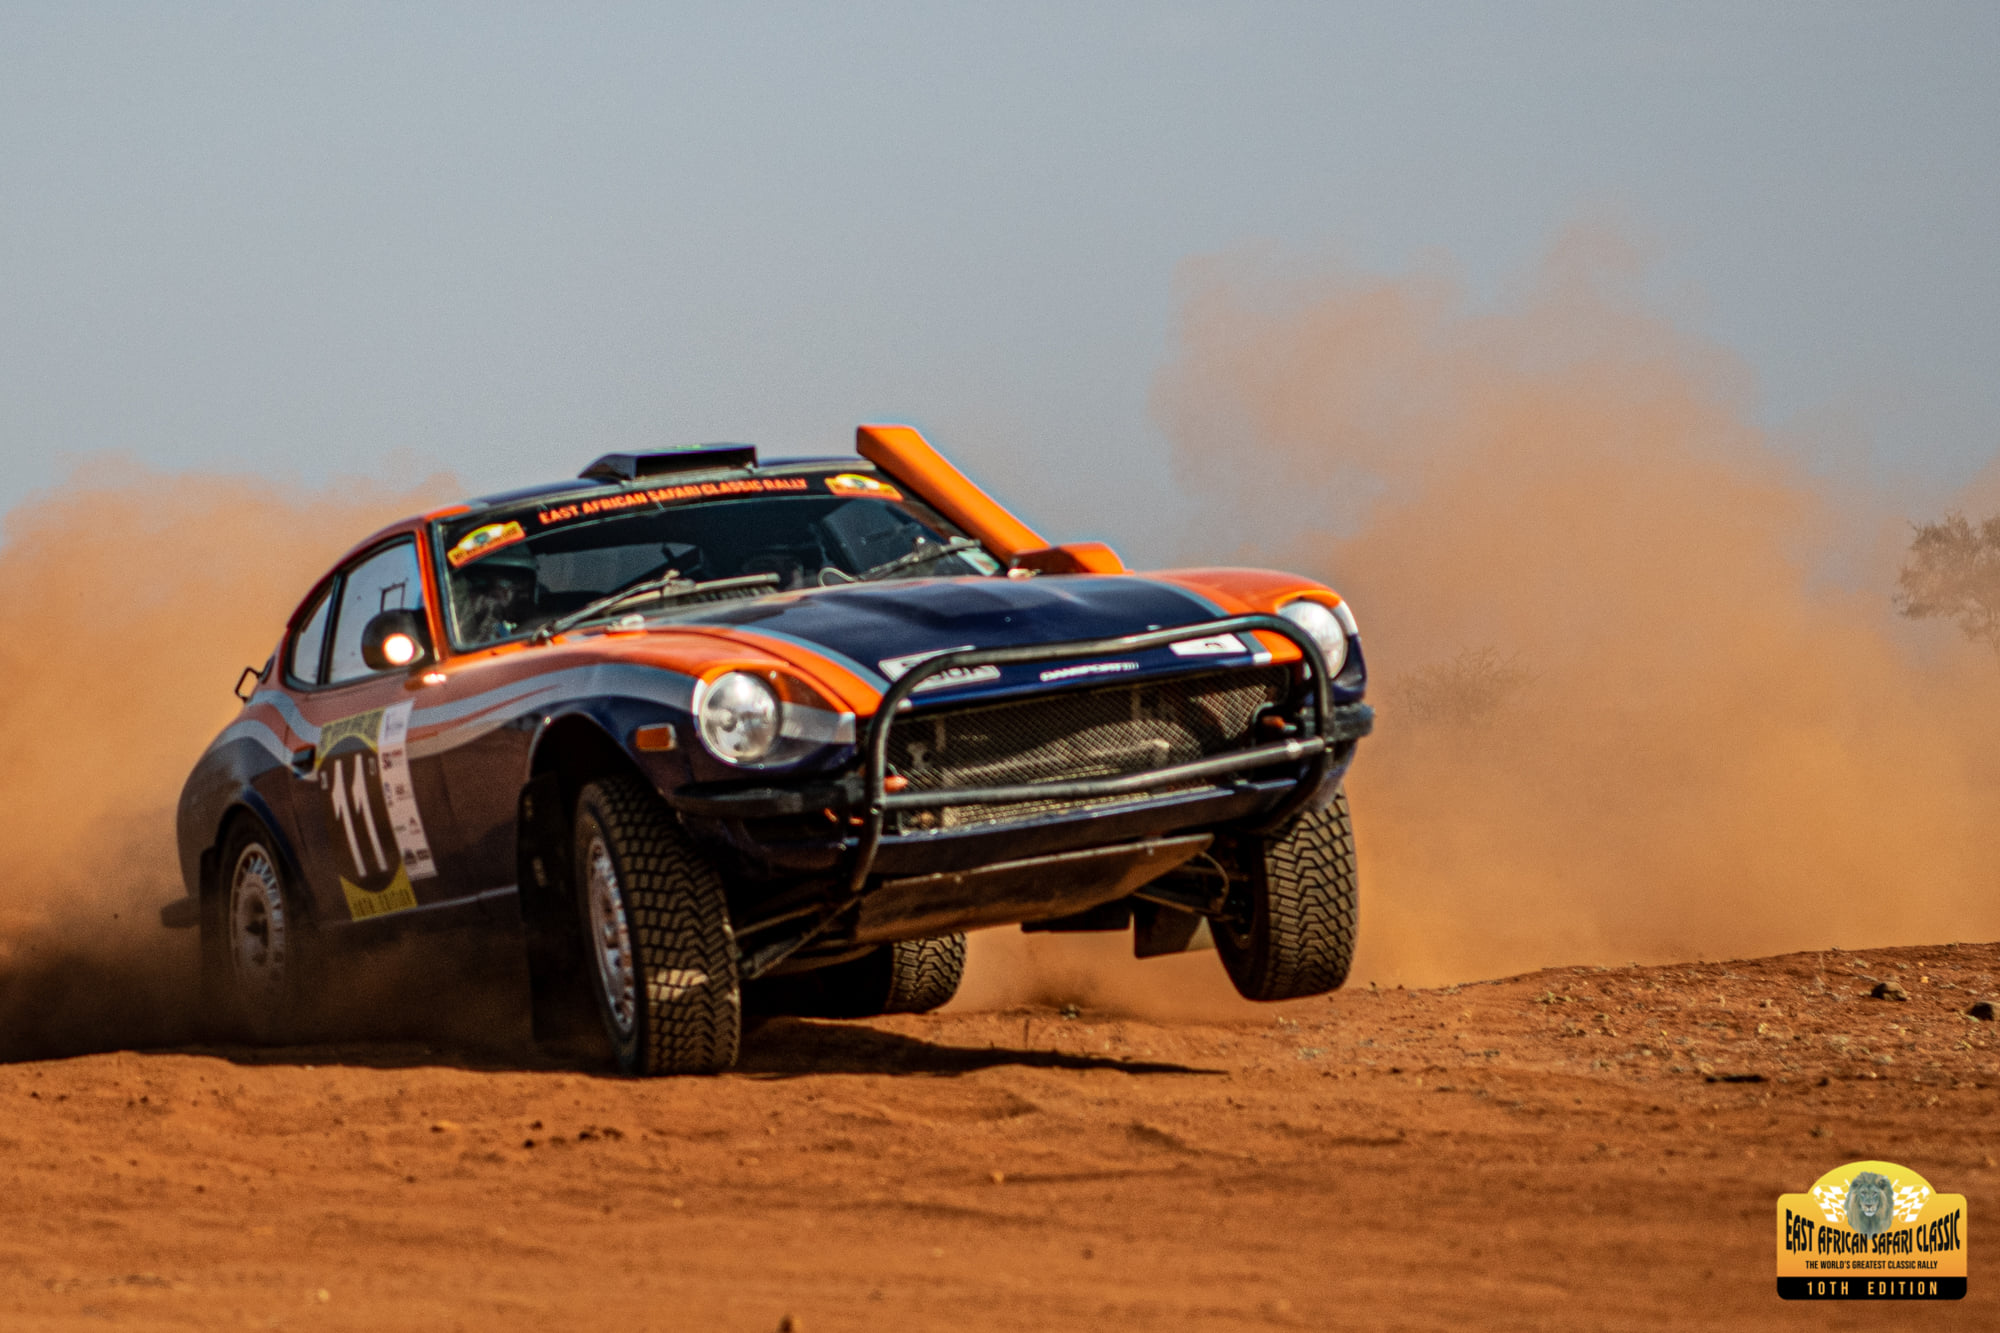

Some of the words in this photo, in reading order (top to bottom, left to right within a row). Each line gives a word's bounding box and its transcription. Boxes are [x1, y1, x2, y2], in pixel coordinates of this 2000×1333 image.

[538, 504, 579, 525] EAST
[581, 492, 648, 515] AFRICAN
[647, 485, 701, 503] SAFARI
[700, 480, 763, 497] CLASSIC
[762, 477, 808, 492] RALLY
[331, 752, 388, 878] 11
